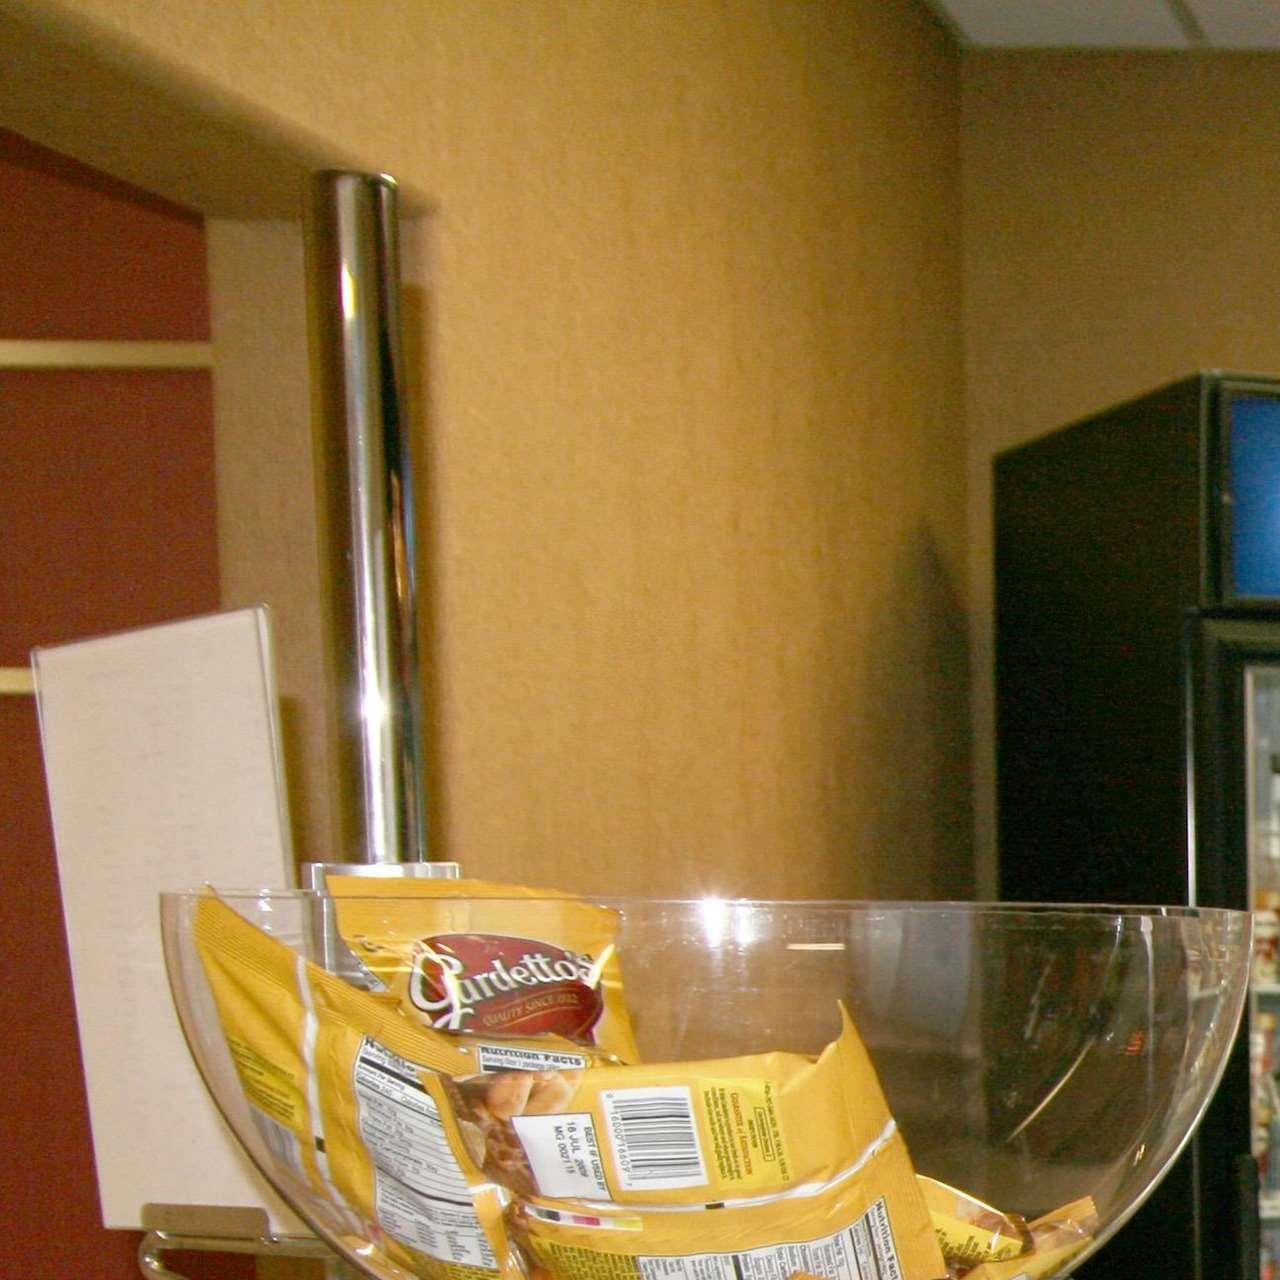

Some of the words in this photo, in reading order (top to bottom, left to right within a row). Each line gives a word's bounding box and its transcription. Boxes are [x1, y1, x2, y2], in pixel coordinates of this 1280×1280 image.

[482, 1007, 524, 1027] QUALITY
[553, 1126, 565, 1141] MG
[583, 1126, 597, 1148] BEST
[569, 1135, 582, 1154] JUL
[588, 1149, 598, 1157] IF
[590, 1159, 603, 1181] USED
